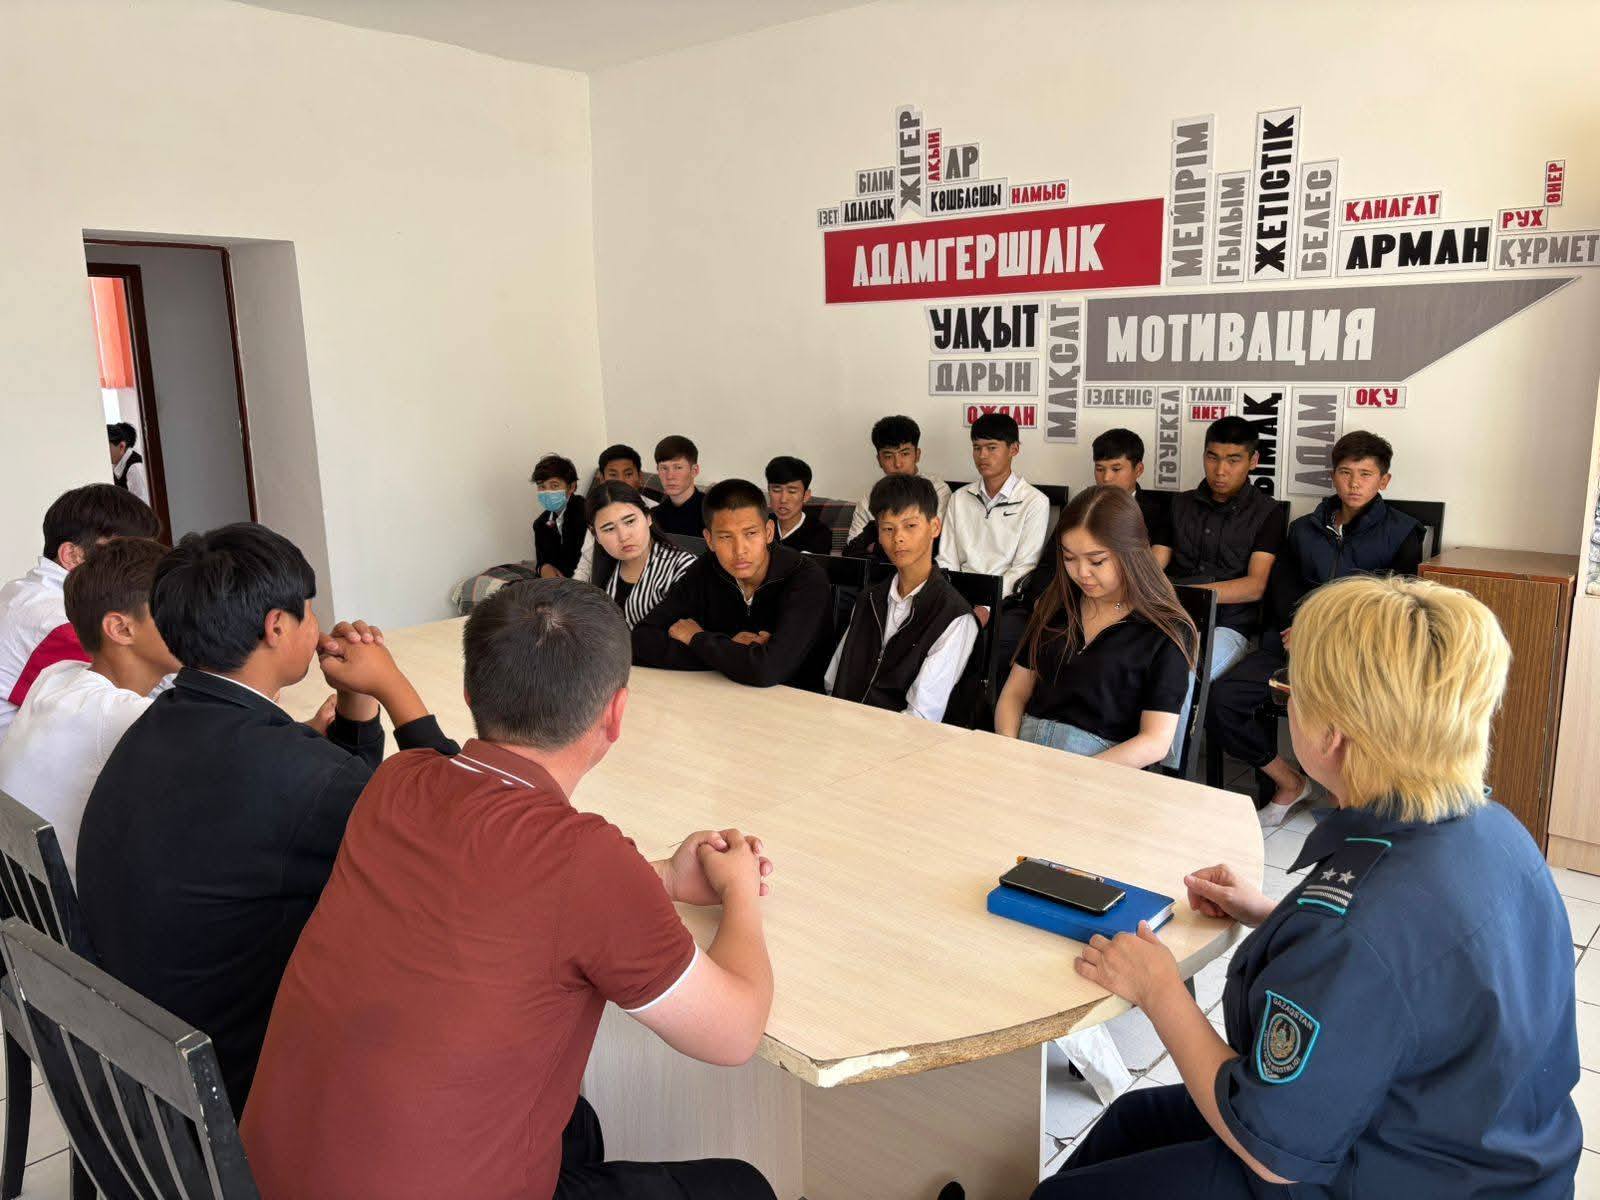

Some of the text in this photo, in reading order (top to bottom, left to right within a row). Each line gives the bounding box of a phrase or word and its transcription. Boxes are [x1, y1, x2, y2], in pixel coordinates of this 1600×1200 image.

[900, 111, 920, 208] ЖІГЕР
[945, 145, 979, 180] АР
[859, 170, 894, 194] БІЛІМ
[930, 184, 1002, 213] КӨШБАСШЫ
[1011, 179, 1066, 204] НАМЫС
[1170, 122, 1208, 277] МЕЙІРІМ
[1254, 115, 1294, 274] ЖЕТІСТІК
[844, 198, 895, 223] АДАЛДЫҚ
[1301, 170, 1332, 271] БЕЛЕС
[1345, 194, 1440, 222] ҚАНАҒАТ
[1502, 209, 1544, 229] РУХ
[1216, 177, 1245, 277] ҒЫЛЫМ
[852, 223, 1105, 288] АДАМГЕРШІЛІК
[1345, 226, 1490, 270] АРМАН
[1499, 234, 1600, 267] ҚҰРМЕТ
[929, 304, 1039, 352] УАҚЫТ
[1106, 308, 1376, 366] МОТИВАЦИЯ
[935, 362, 1031, 392] ДАРЫН
[1047, 304, 1081, 438] МАҚСАТ
[1087, 389, 1153, 406] ІЗДЕНІС
[1190, 388, 1232, 402] ТАЛАП
[1355, 389, 1399, 408] ОҚУ
[1192, 406, 1227, 420] НИЕТ
[1159, 390, 1180, 485] ТӘУЕКЕЛ
[1295, 395, 1337, 489] АДАМ
